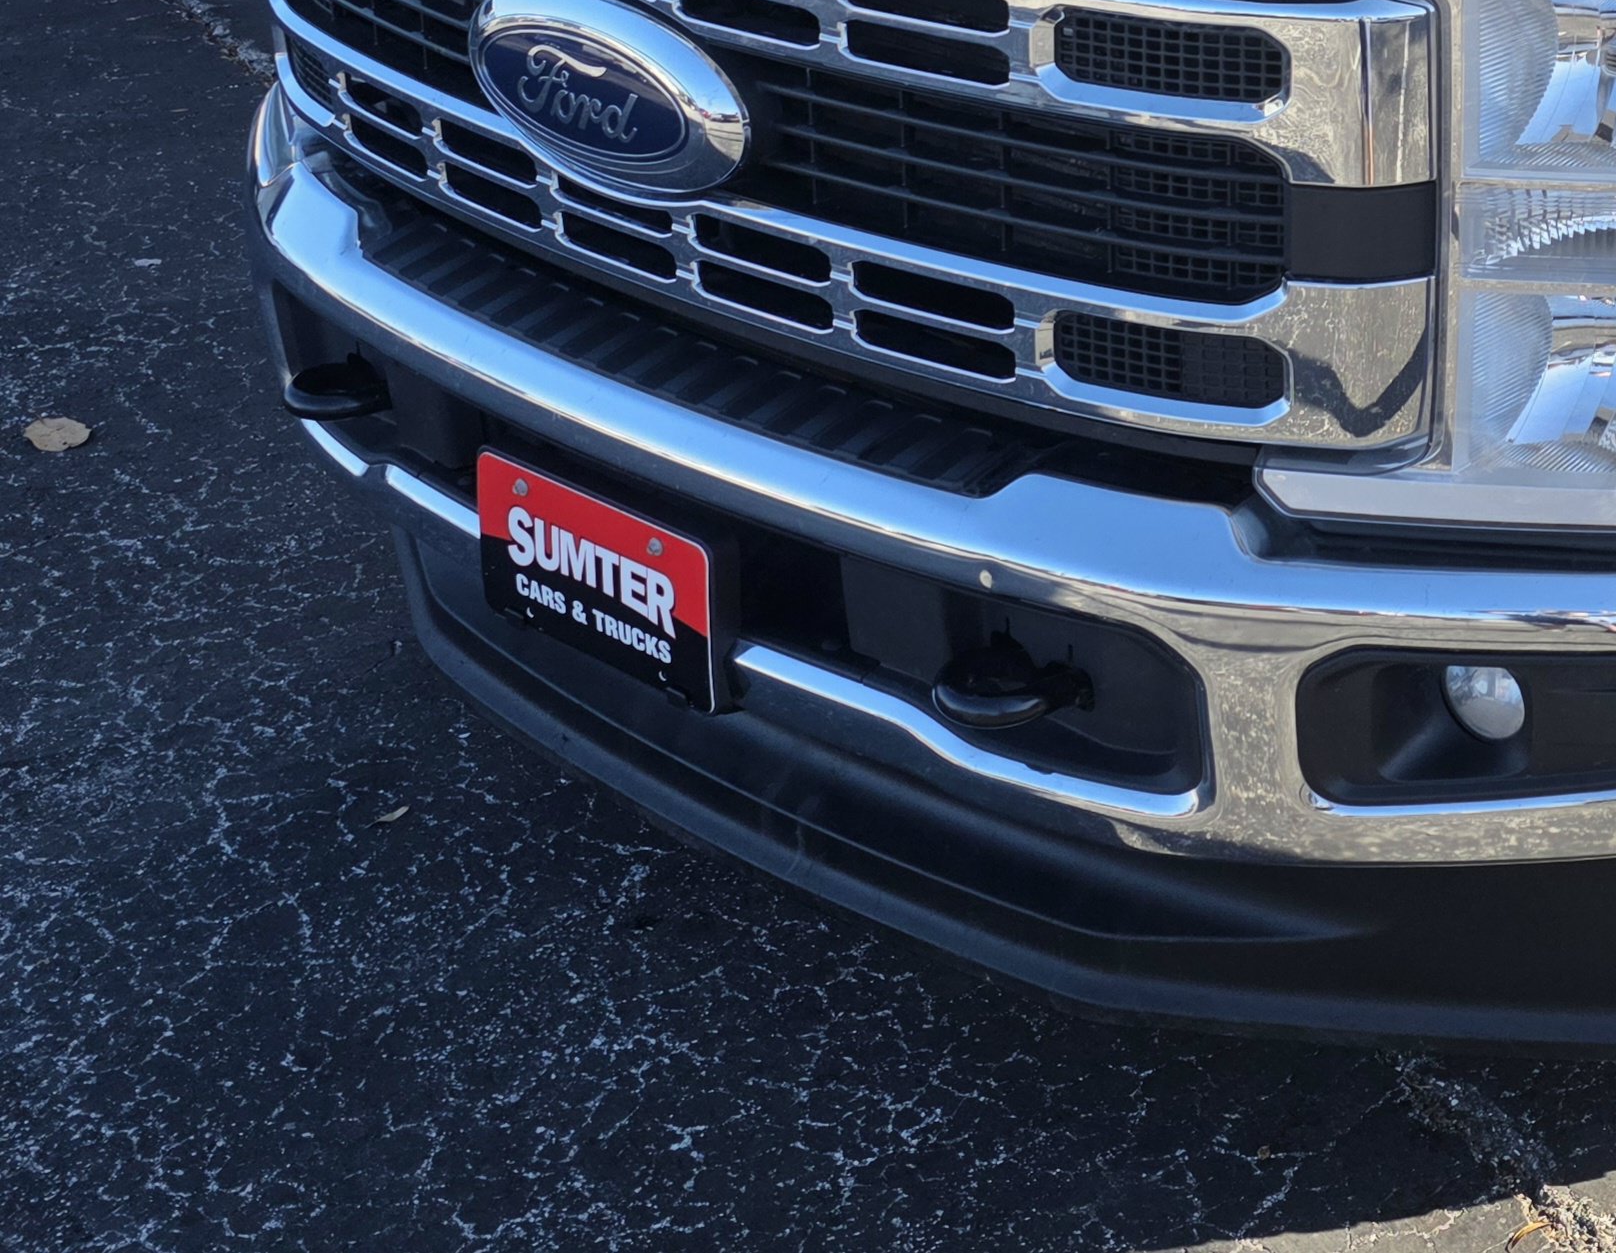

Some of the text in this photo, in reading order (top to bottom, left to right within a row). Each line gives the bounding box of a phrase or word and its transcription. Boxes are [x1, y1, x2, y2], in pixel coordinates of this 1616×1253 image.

[517, 45, 638, 144] Ford
[508, 506, 676, 639] SUMTER
[515, 573, 672, 664] CARS & TRUCKS
